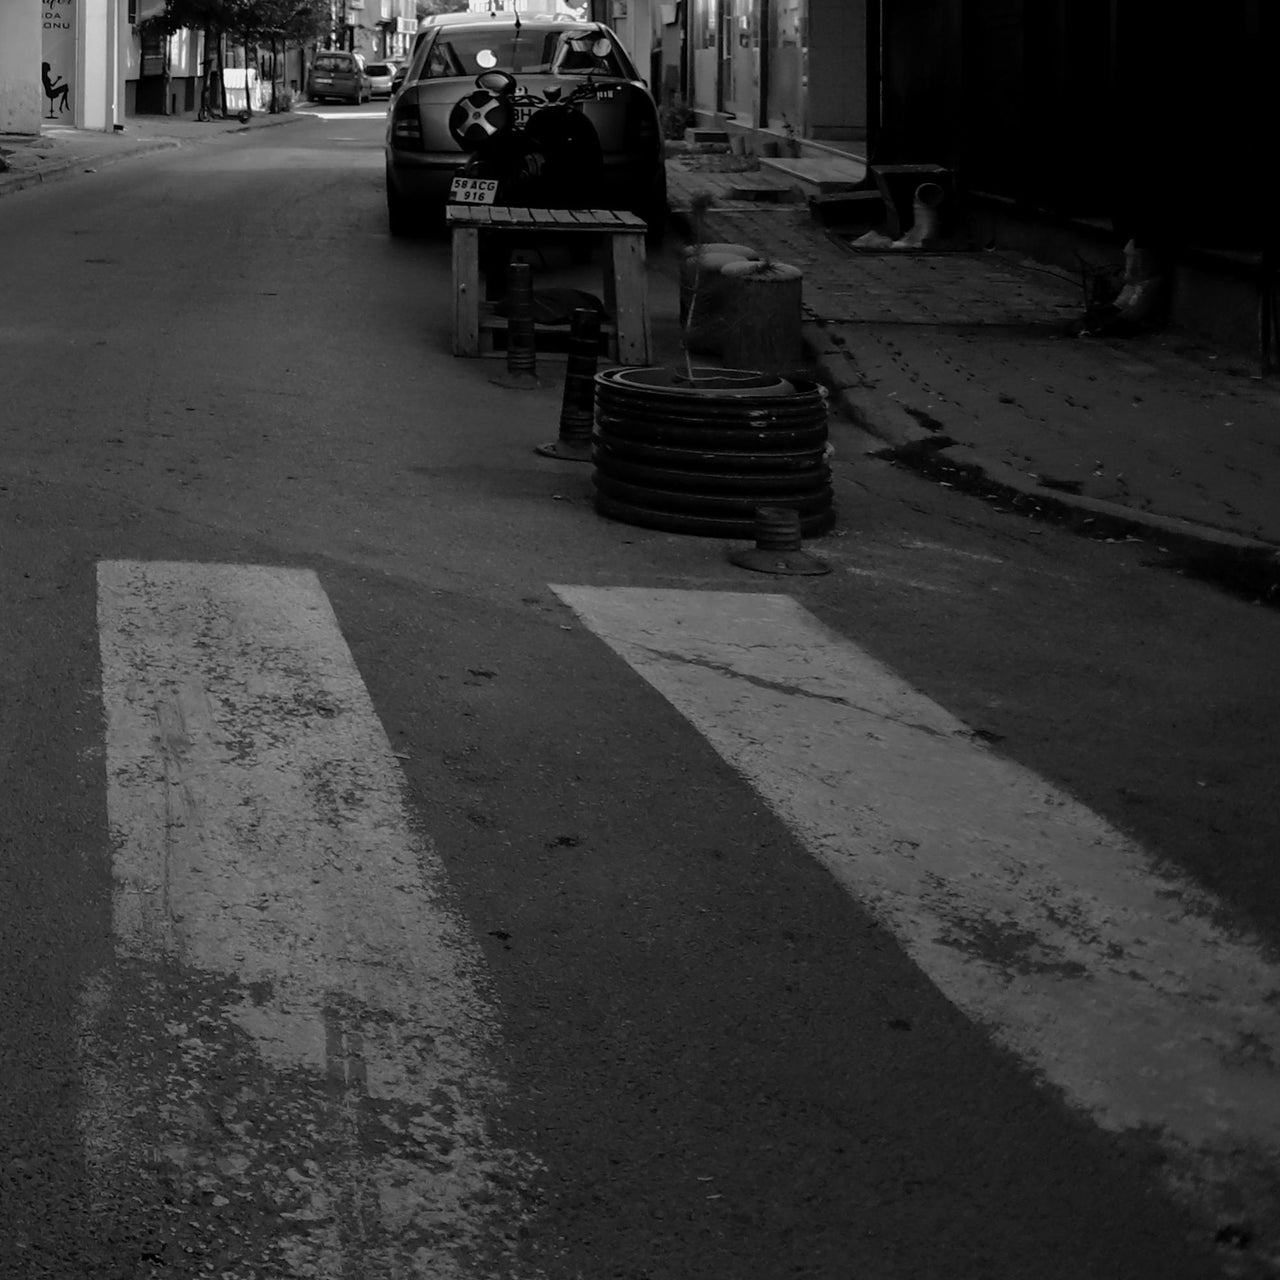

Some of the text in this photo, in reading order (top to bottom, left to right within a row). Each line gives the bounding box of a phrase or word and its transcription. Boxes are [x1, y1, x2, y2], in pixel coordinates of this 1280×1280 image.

[454, 179, 496, 191] 58 ACG
[464, 191, 485, 201] 916
